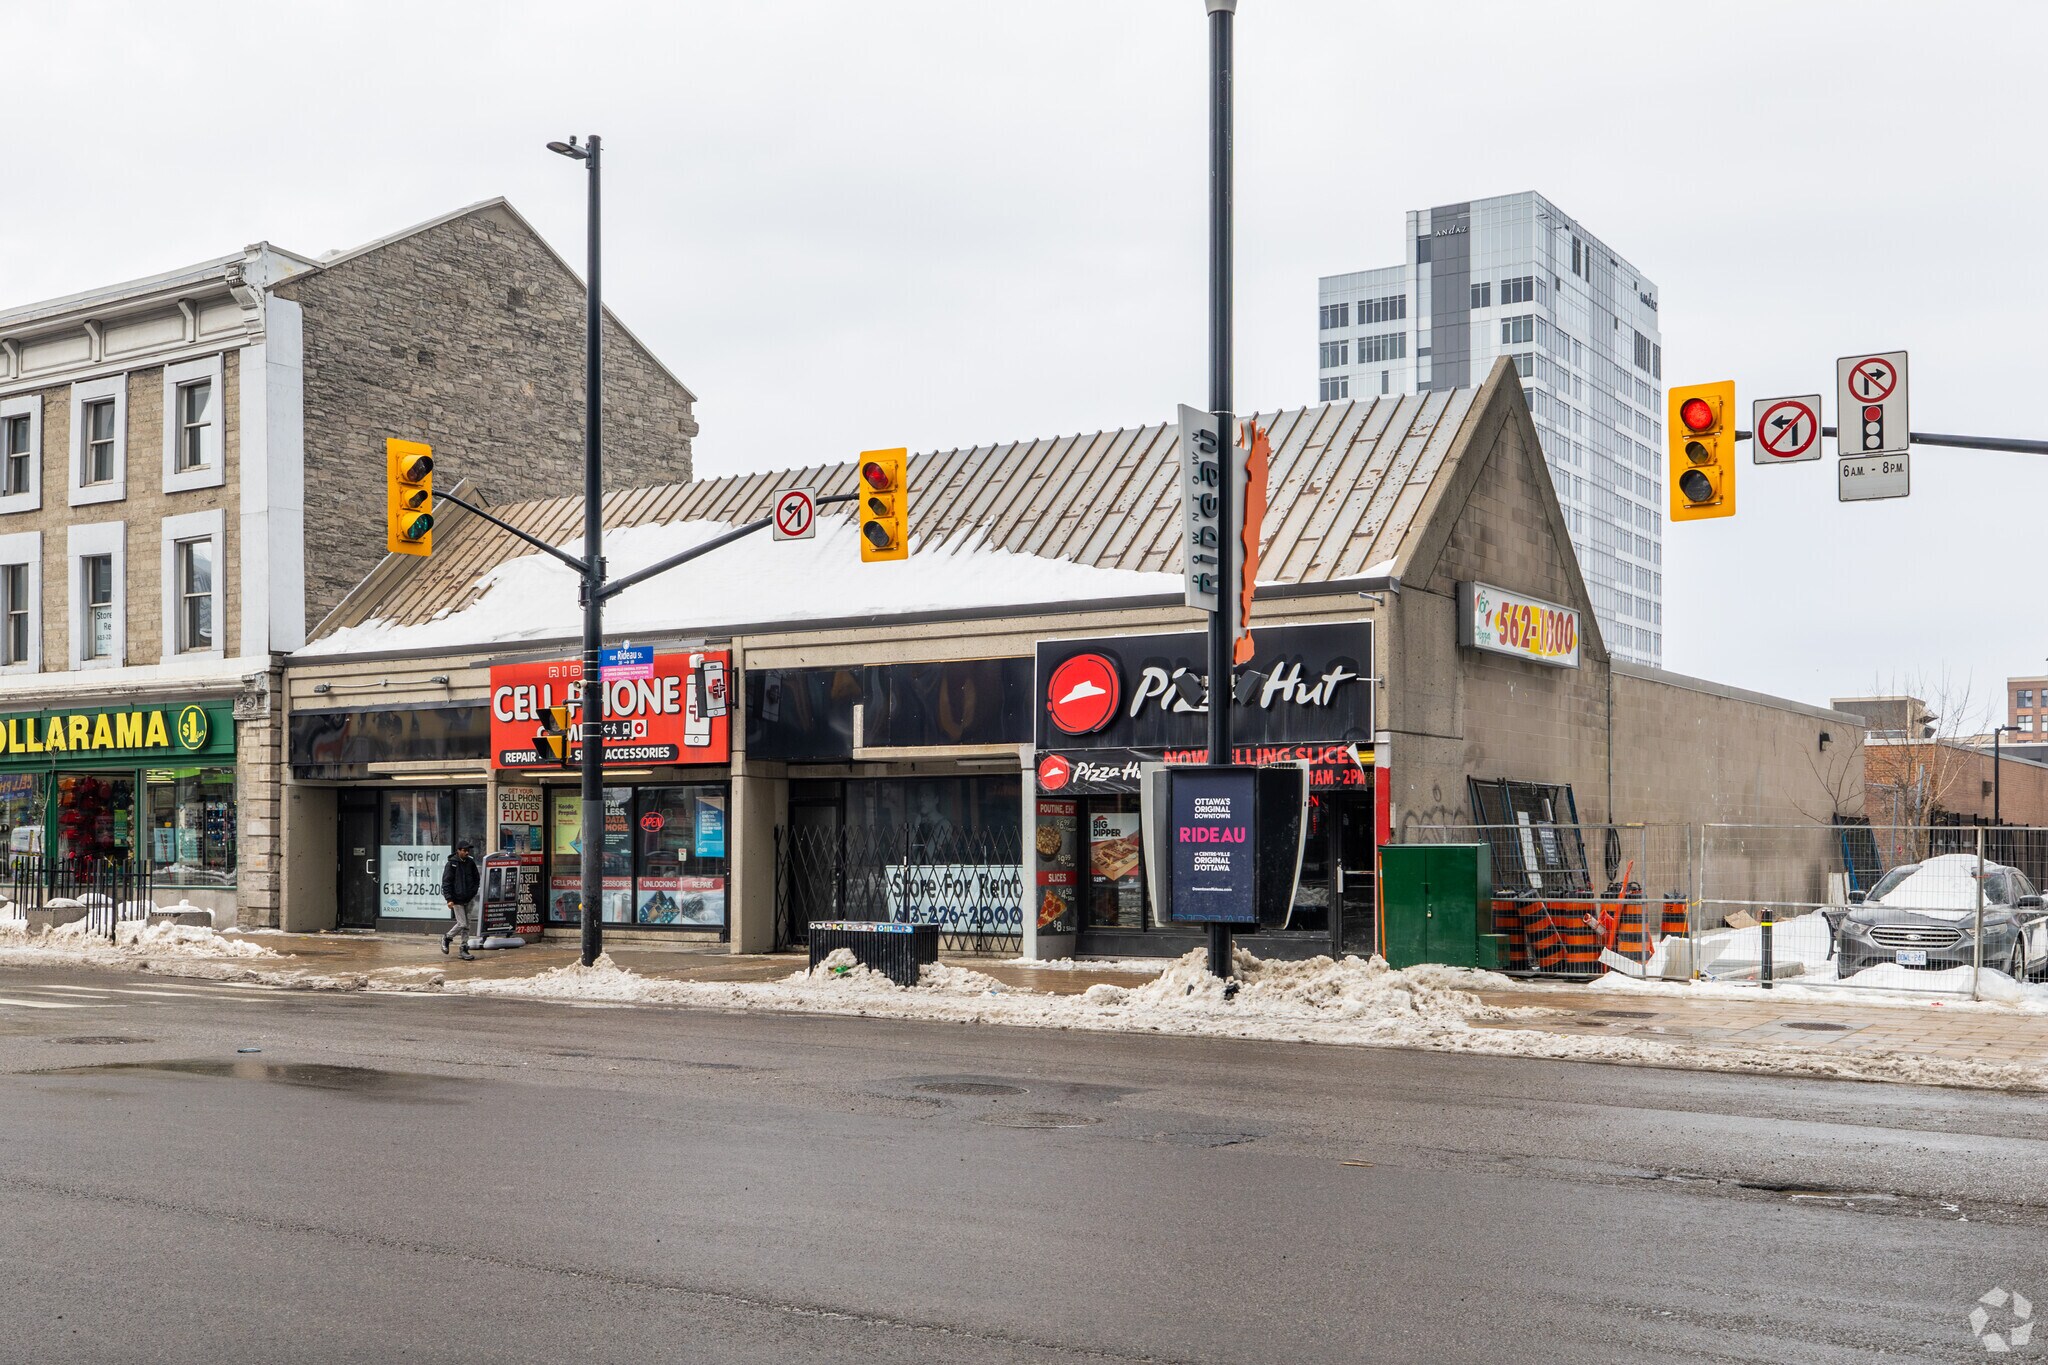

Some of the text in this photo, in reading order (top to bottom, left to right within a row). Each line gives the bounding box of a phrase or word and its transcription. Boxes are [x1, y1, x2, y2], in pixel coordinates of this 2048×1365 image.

[1844, 464, 1850, 477] 6
[1851, 466, 1865, 476] A.M.
[1883, 462, 1889, 474] 8
[1890, 463, 1904, 473] P.M.
[1192, 432, 1200, 584] DOWNTOWN
[1499, 602, 1574, 654] 562-1800
[618, 650, 637, 660] Rideau
[549, 665, 582, 678] RID
[1260, 661, 1357, 709] Hut
[506, 752, 536, 763] REPAIR
[605, 747, 670, 760] ACCESSORIES
[1295, 745, 1356, 765] SLICE
[1072, 762, 1120, 783] Pizza
[518, 794, 542, 802] PHONE
[503, 810, 538, 821] FIXED
[605, 824, 629, 832] MORE.
[642, 816, 662, 828] OPEN
[1180, 827, 1246, 843] RIDEAU
[398, 850, 440, 862] Store For
[408, 866, 430, 878] Rent
[1048, 873, 1066, 882] SLICES
[525, 874, 538, 883] SELL
[383, 883, 444, 895] 613-226-20
[519, 884, 530, 893] ADE
[893, 873, 1022, 898] Sore For Rent
[518, 894, 532, 903] AIRS
[896, 905, 1023, 924] 63-226-2000
[1053, 920, 1062, 932] $8
